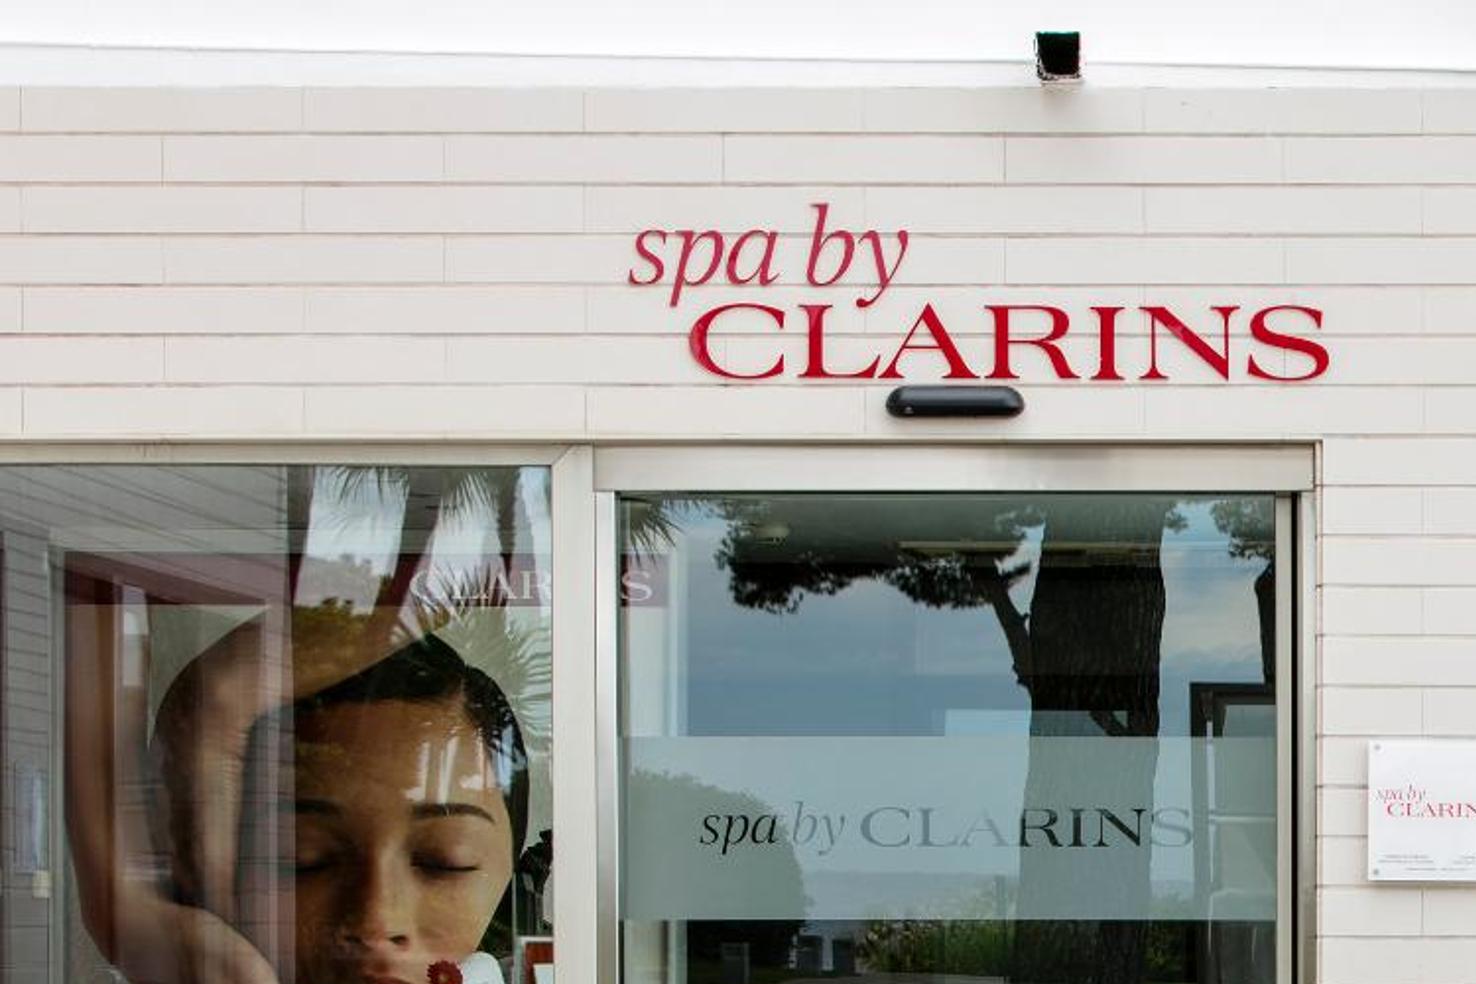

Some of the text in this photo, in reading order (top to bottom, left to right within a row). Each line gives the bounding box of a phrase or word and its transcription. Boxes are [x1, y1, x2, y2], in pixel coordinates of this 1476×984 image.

[628, 202, 910, 309] spa by
[688, 302, 1330, 382] CLARINS
[699, 800, 1195, 855] spa by CLARINS
